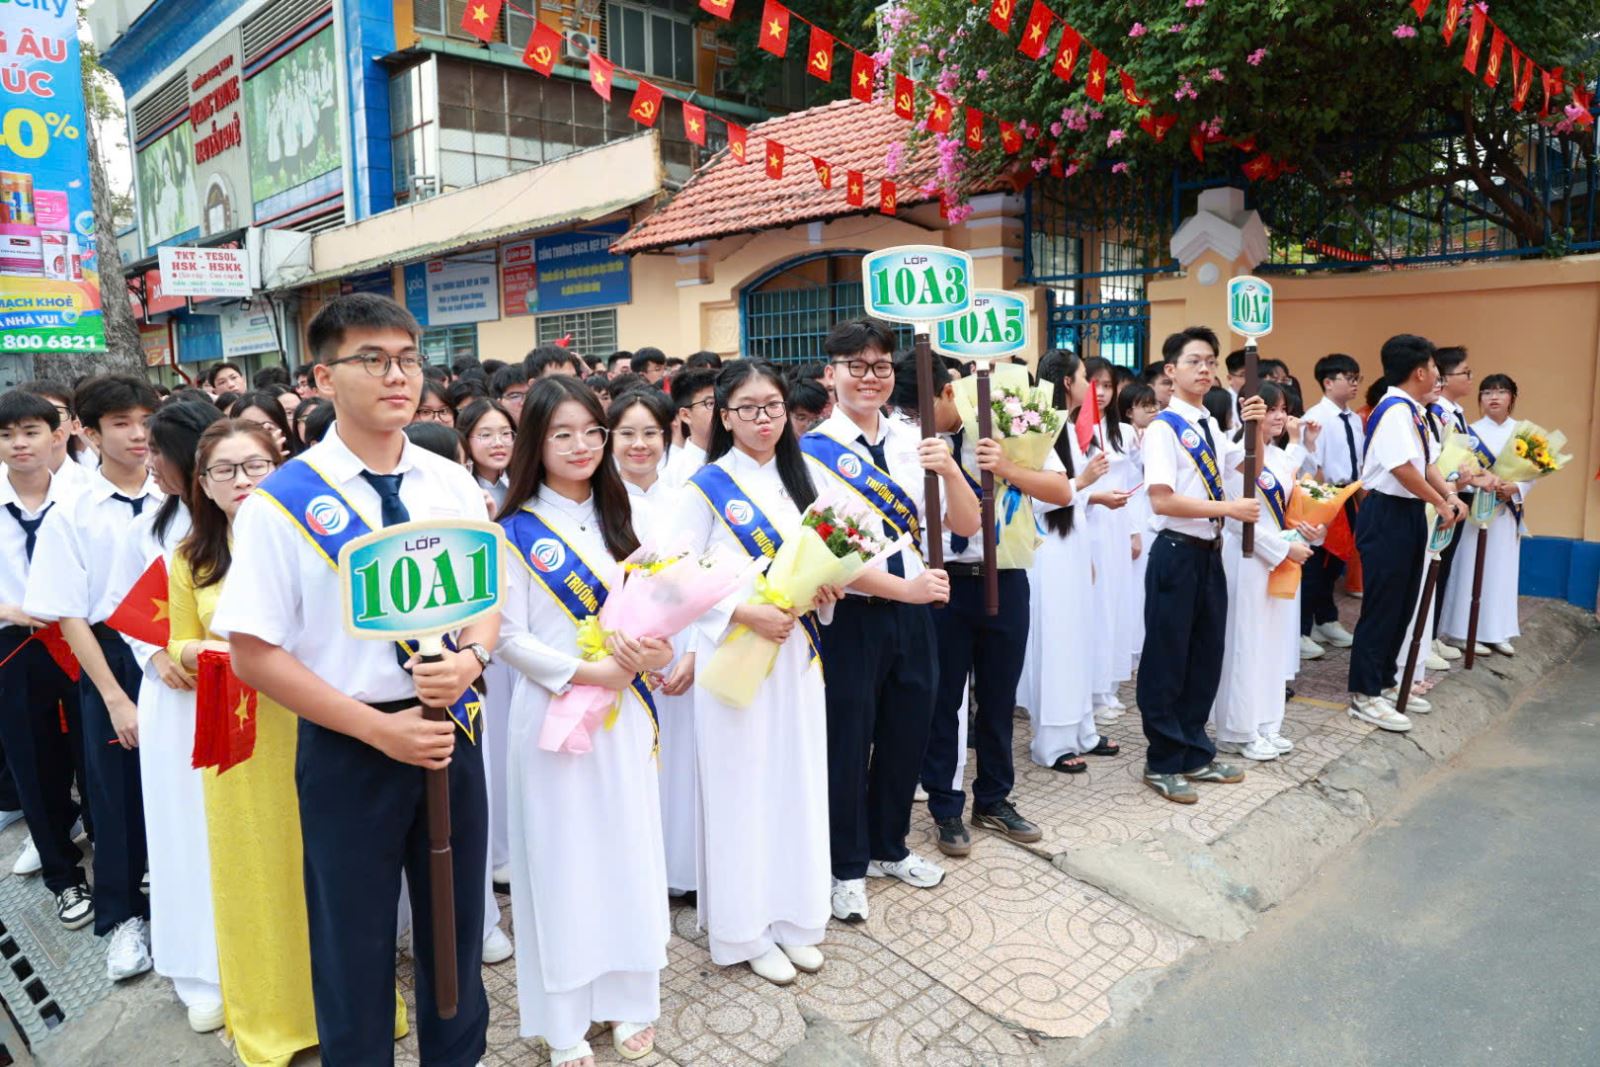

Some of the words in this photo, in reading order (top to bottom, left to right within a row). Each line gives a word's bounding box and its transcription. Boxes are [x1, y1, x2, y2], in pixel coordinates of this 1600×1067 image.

[16, 28, 66, 62] ÂU
[2, 63, 55, 97] ÚC
[0, 108, 79, 158] 0%
[172, 262, 197, 270] HSK
[209, 263, 241, 271] HSKK
[175, 251, 196, 260] TKT
[205, 252, 236, 261] TESOL
[903, 256, 928, 265] LỚP
[874, 266, 967, 306] 10A3
[974, 298, 990, 306] ỚP
[5, 313, 34, 326] NHÀ
[36, 314, 58, 324] VUI
[1233, 292, 1270, 323] 10A7
[941, 307, 1023, 343] 10A5
[47, 335, 96, 349] 6821
[866, 476, 895, 504] TRƯỜNG
[893, 499, 910, 519] THPT
[405, 536, 440, 551] LỚP
[356, 544, 494, 620] 10A1
[564, 570, 598, 612] TRƯỜNG
